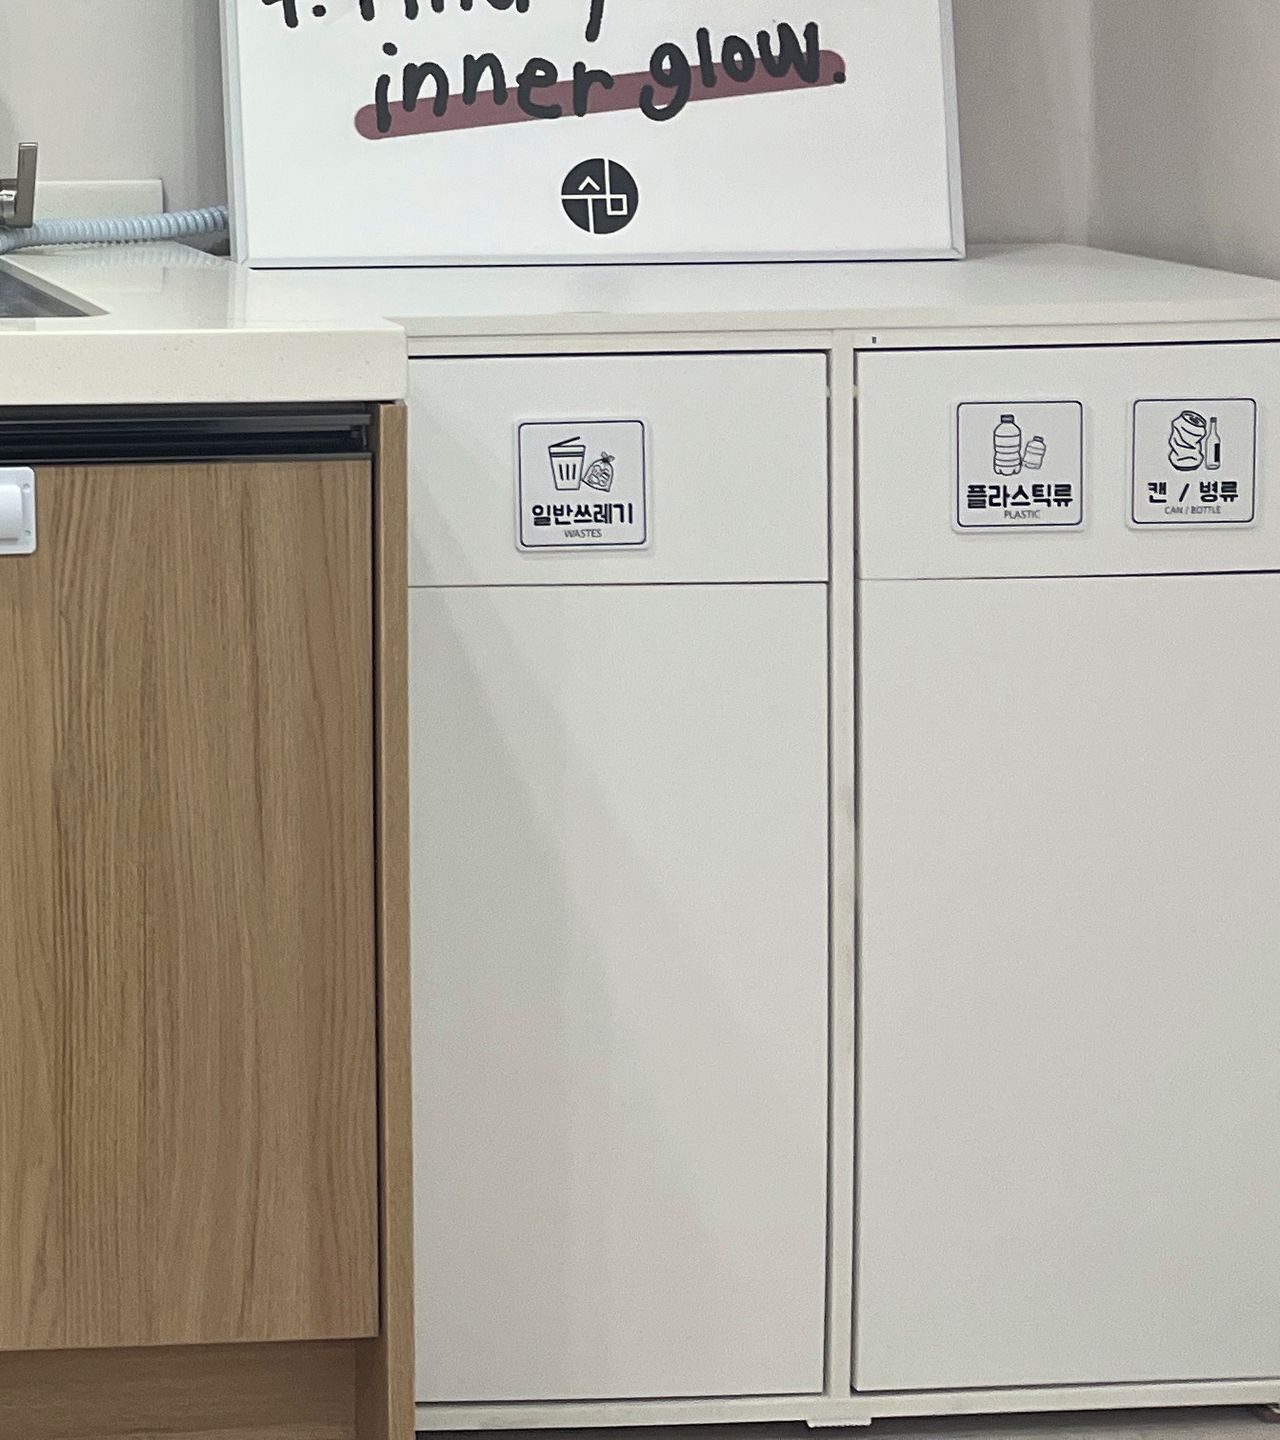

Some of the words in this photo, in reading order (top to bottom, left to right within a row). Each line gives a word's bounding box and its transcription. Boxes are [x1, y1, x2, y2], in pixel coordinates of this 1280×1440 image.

[374, 41, 614, 134] inner
[639, 22, 847, 122] glow.
[966, 483, 1074, 509] 플라스틱류
[1147, 481, 1167, 503] 캔
[1200, 480, 1239, 503] 병류
[531, 502, 633, 527] 일반쓰레기
[1004, 509, 1041, 520] PLASTIC
[1164, 505, 1183, 515] CAN
[1191, 505, 1222, 515] BOTTLE
[563, 528, 603, 538] WASTES
